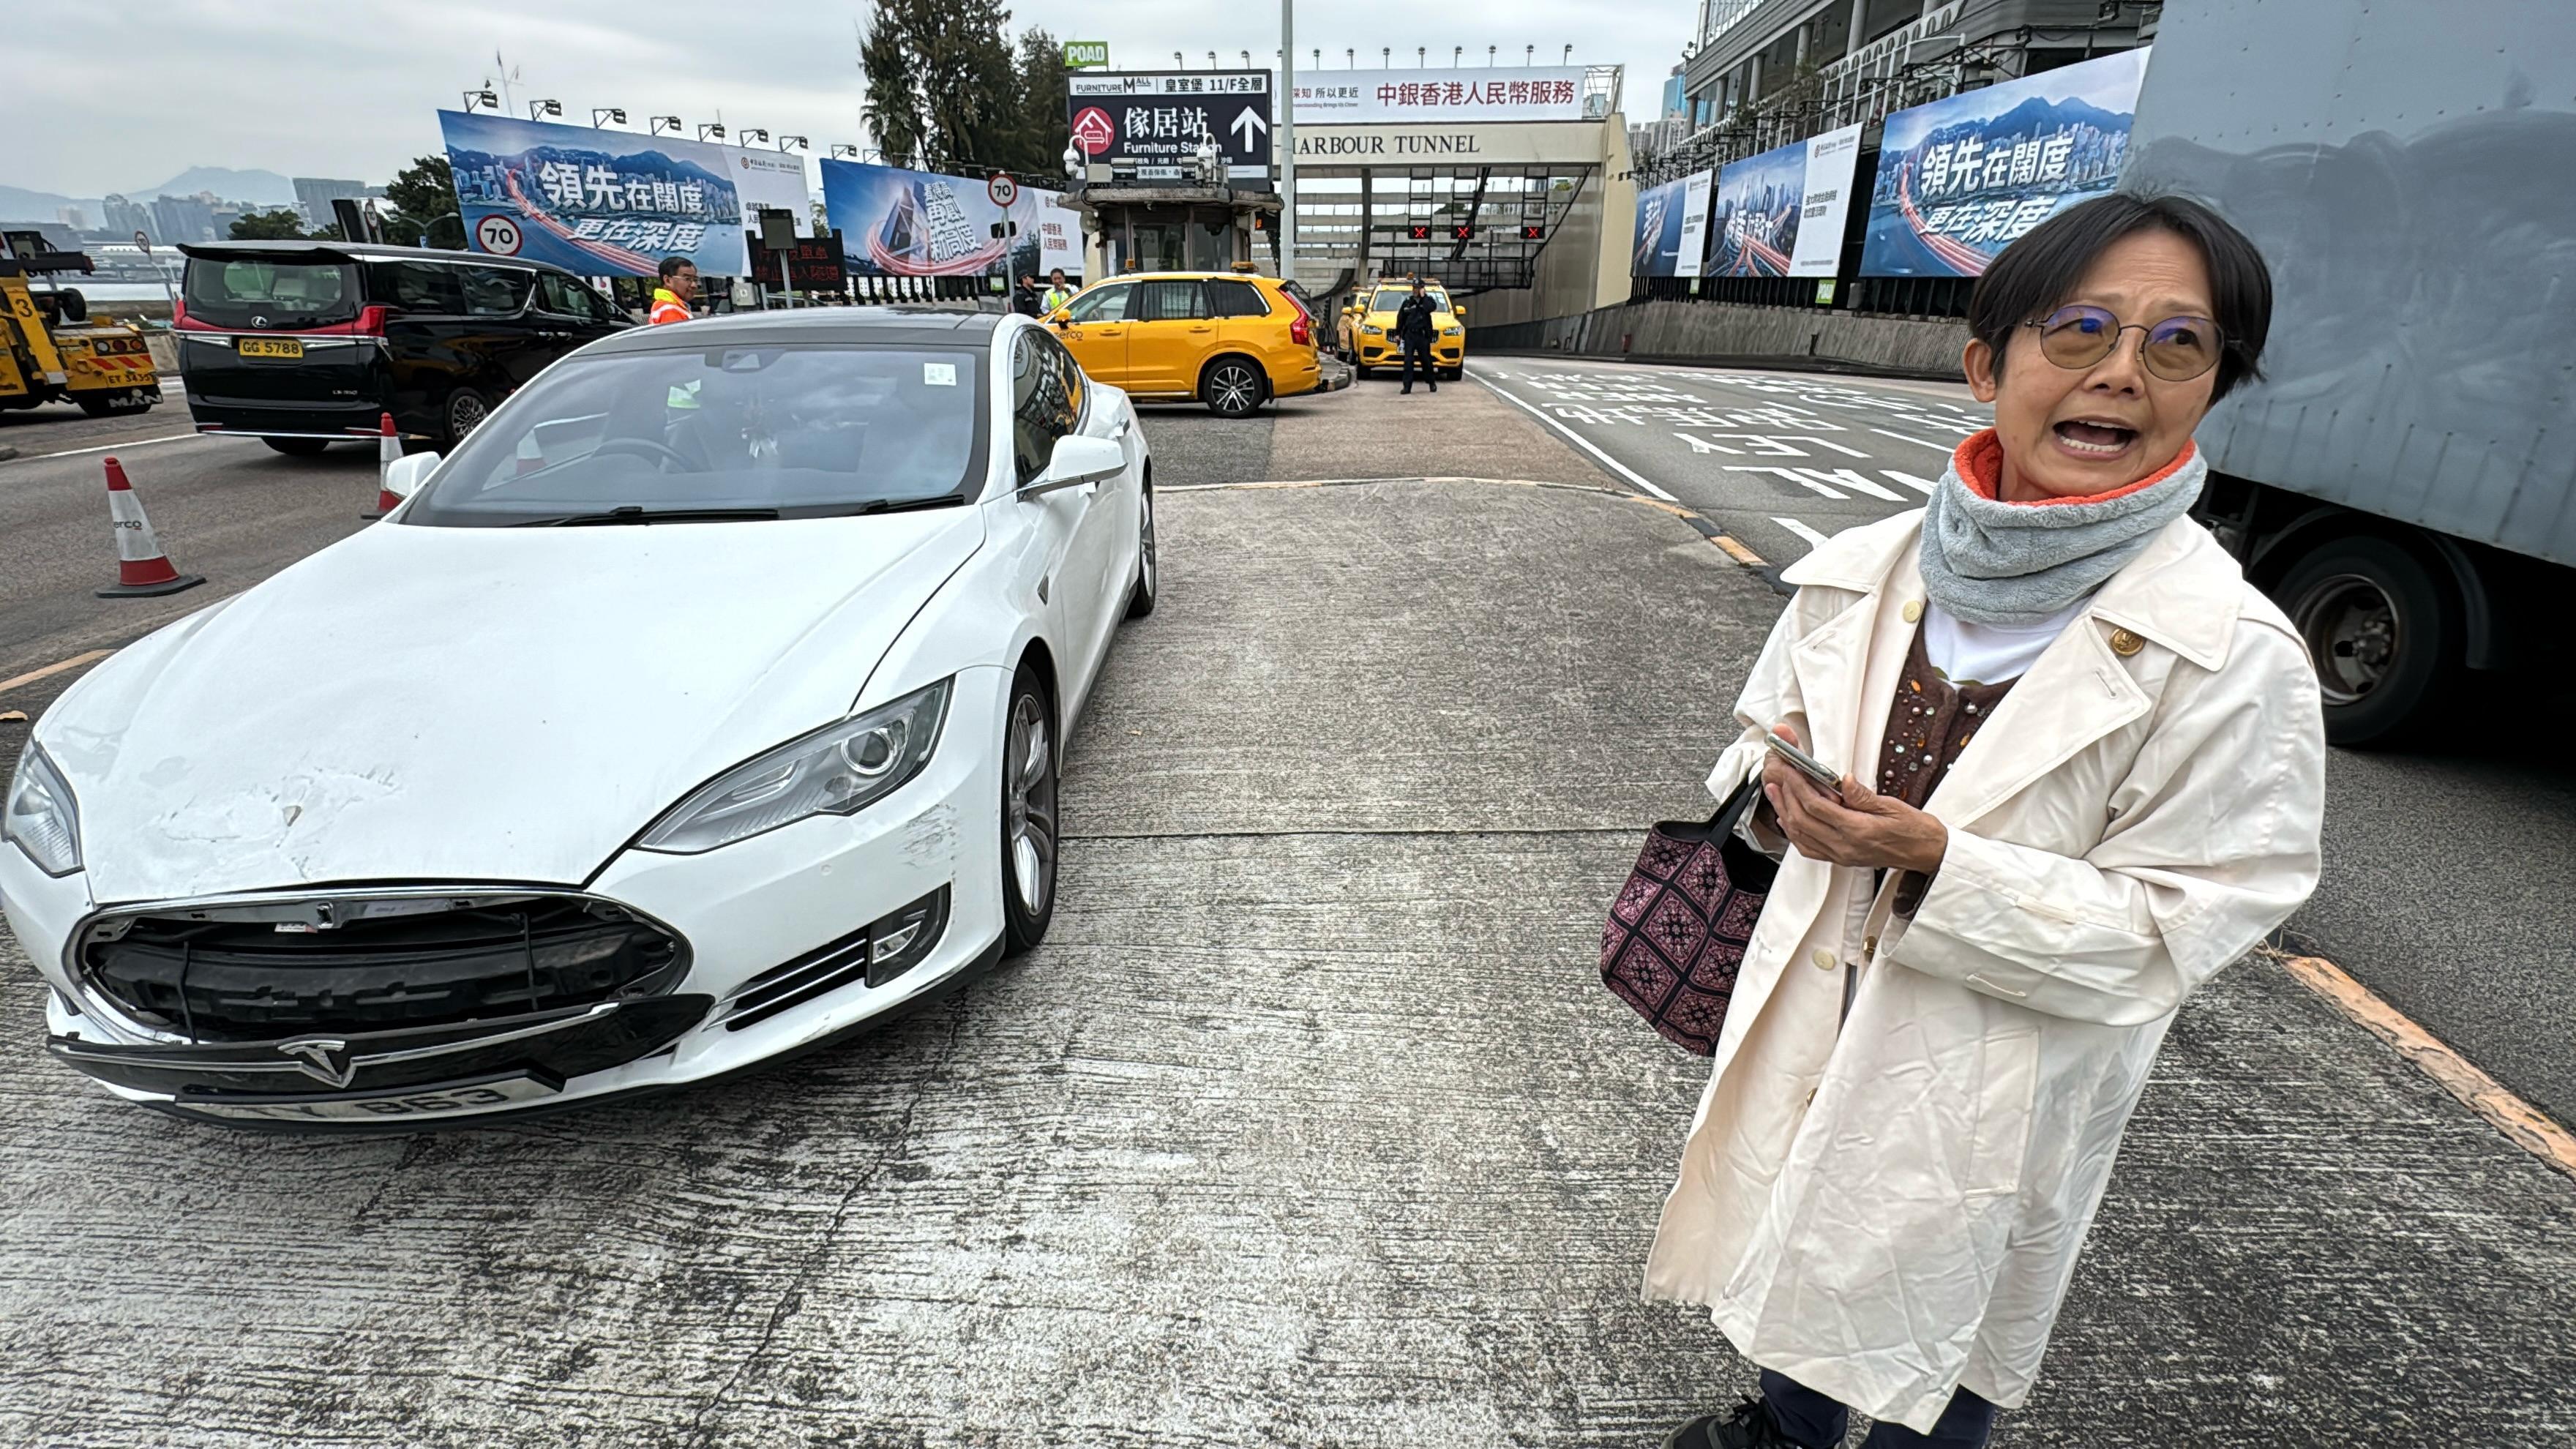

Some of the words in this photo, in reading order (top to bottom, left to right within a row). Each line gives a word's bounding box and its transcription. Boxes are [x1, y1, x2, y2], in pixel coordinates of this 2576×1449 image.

[1068, 45, 1105, 62] POAD
[1077, 84, 1123, 93] FURNITURE
[1165, 78, 1204, 92] 皇室堡
[1315, 87, 1358, 98] 所以更近
[1377, 80, 1574, 106] 中銀香港人民幣服務
[1123, 107, 1208, 139] 傢居站
[1124, 142, 1177, 154] Furniture
[1293, 135, 1385, 154] ARBOUR
[1394, 135, 1480, 154] TUNNEL
[1920, 136, 2075, 198] 領先在闊度
[539, 160, 707, 214] 領先在闊度
[994, 184, 1011, 197] 70
[1918, 195, 2058, 243] 更在深度
[484, 228, 514, 244] 70
[567, 217, 705, 252] 更在深度
[930, 224, 983, 263] 新高度
[15, 299, 33, 318] 3
[243, 342, 260, 353] GG
[264, 342, 299, 354] 5788
[108, 395, 162, 408] MAN
[1672, 432, 1873, 458] LEY
[354, 1088, 509, 1115] 863
